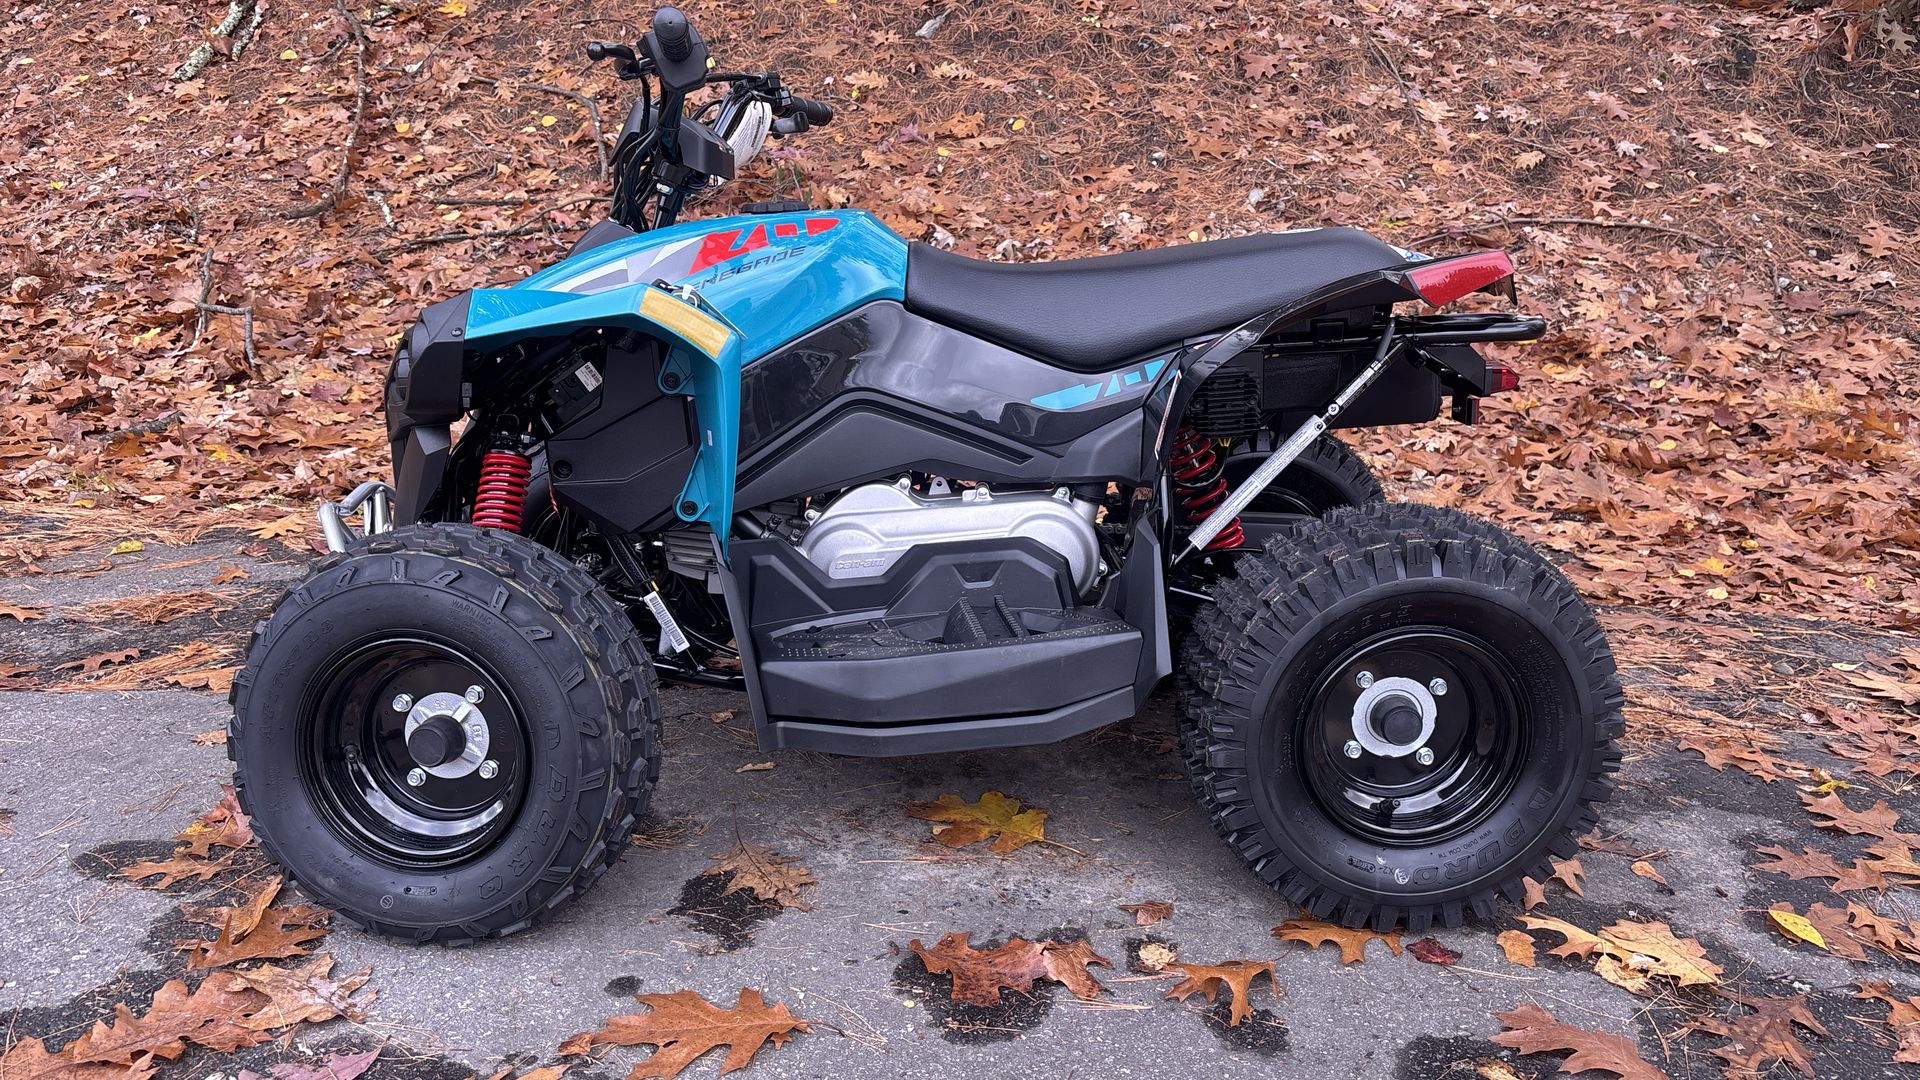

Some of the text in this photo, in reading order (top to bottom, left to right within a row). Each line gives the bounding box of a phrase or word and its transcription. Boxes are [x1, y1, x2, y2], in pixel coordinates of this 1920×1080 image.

[692, 246, 806, 291] ENEGADE
[451, 599, 493, 625] WARNING
[479, 765, 567, 899] DURO
[1412, 818, 1526, 886] DURO
